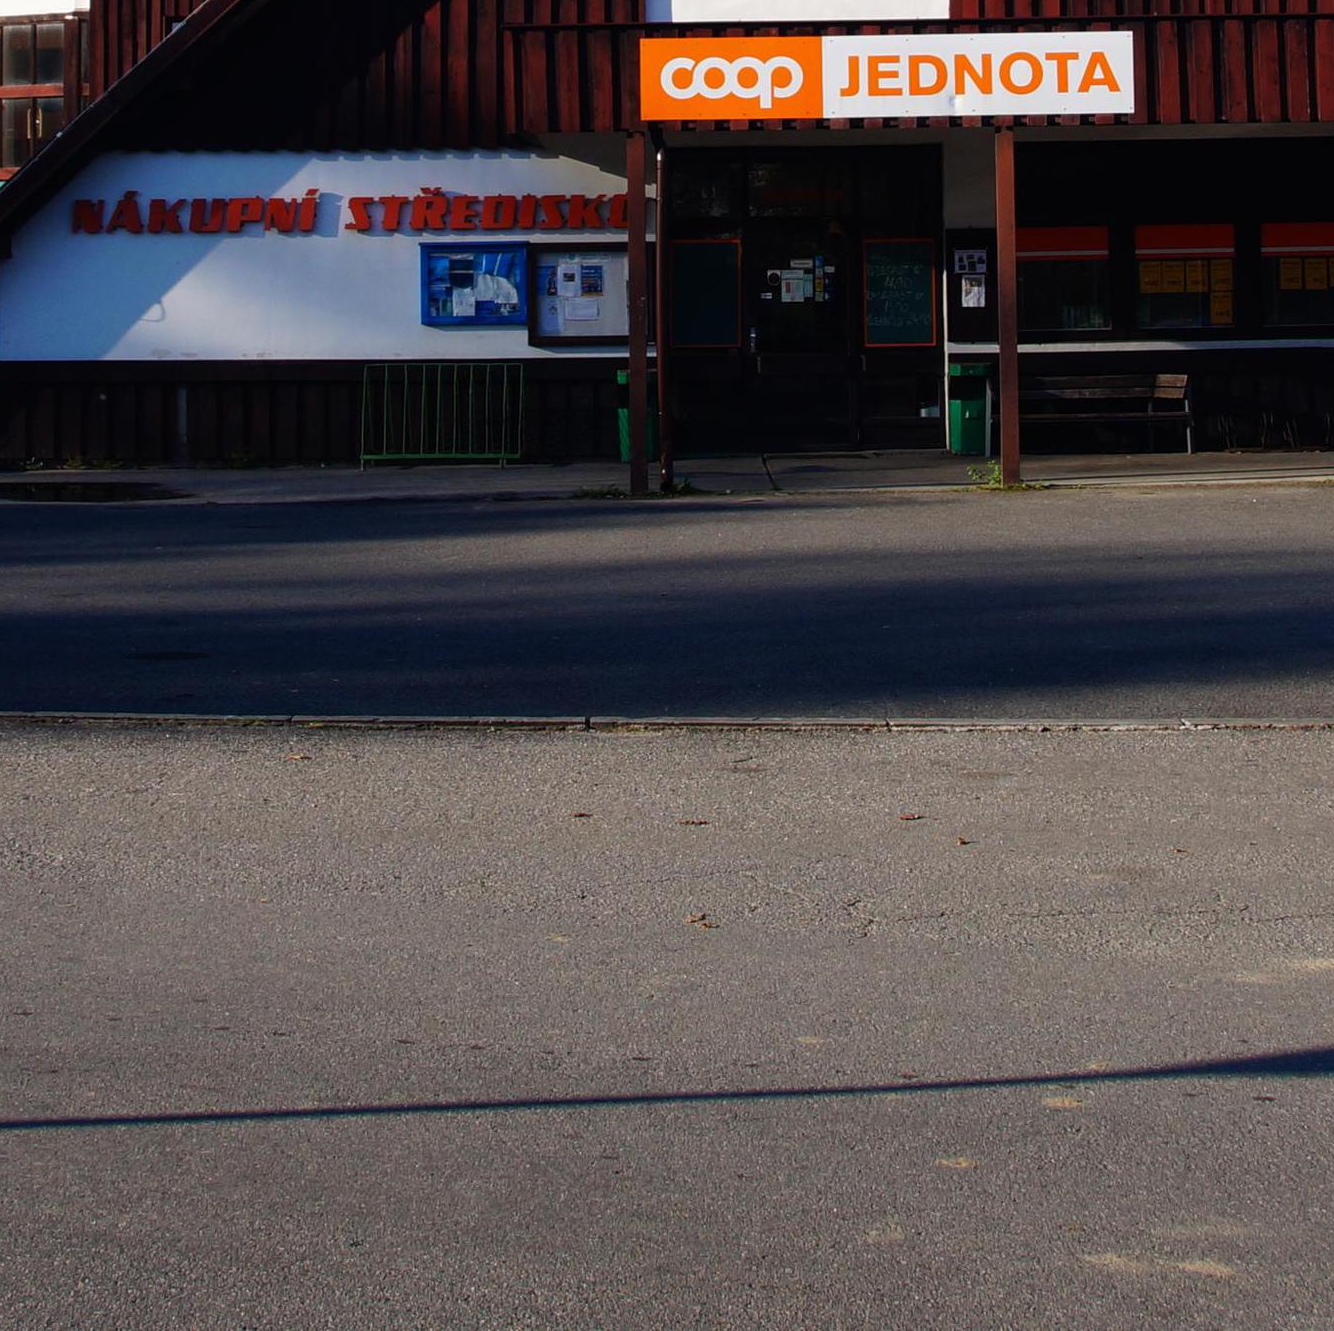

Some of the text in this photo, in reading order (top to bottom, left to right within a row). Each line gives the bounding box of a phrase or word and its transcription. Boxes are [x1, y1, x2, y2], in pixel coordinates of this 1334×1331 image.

[660, 51, 1121, 108] coop JEDNOTA
[72, 188, 319, 234] NÁKUPNÍ
